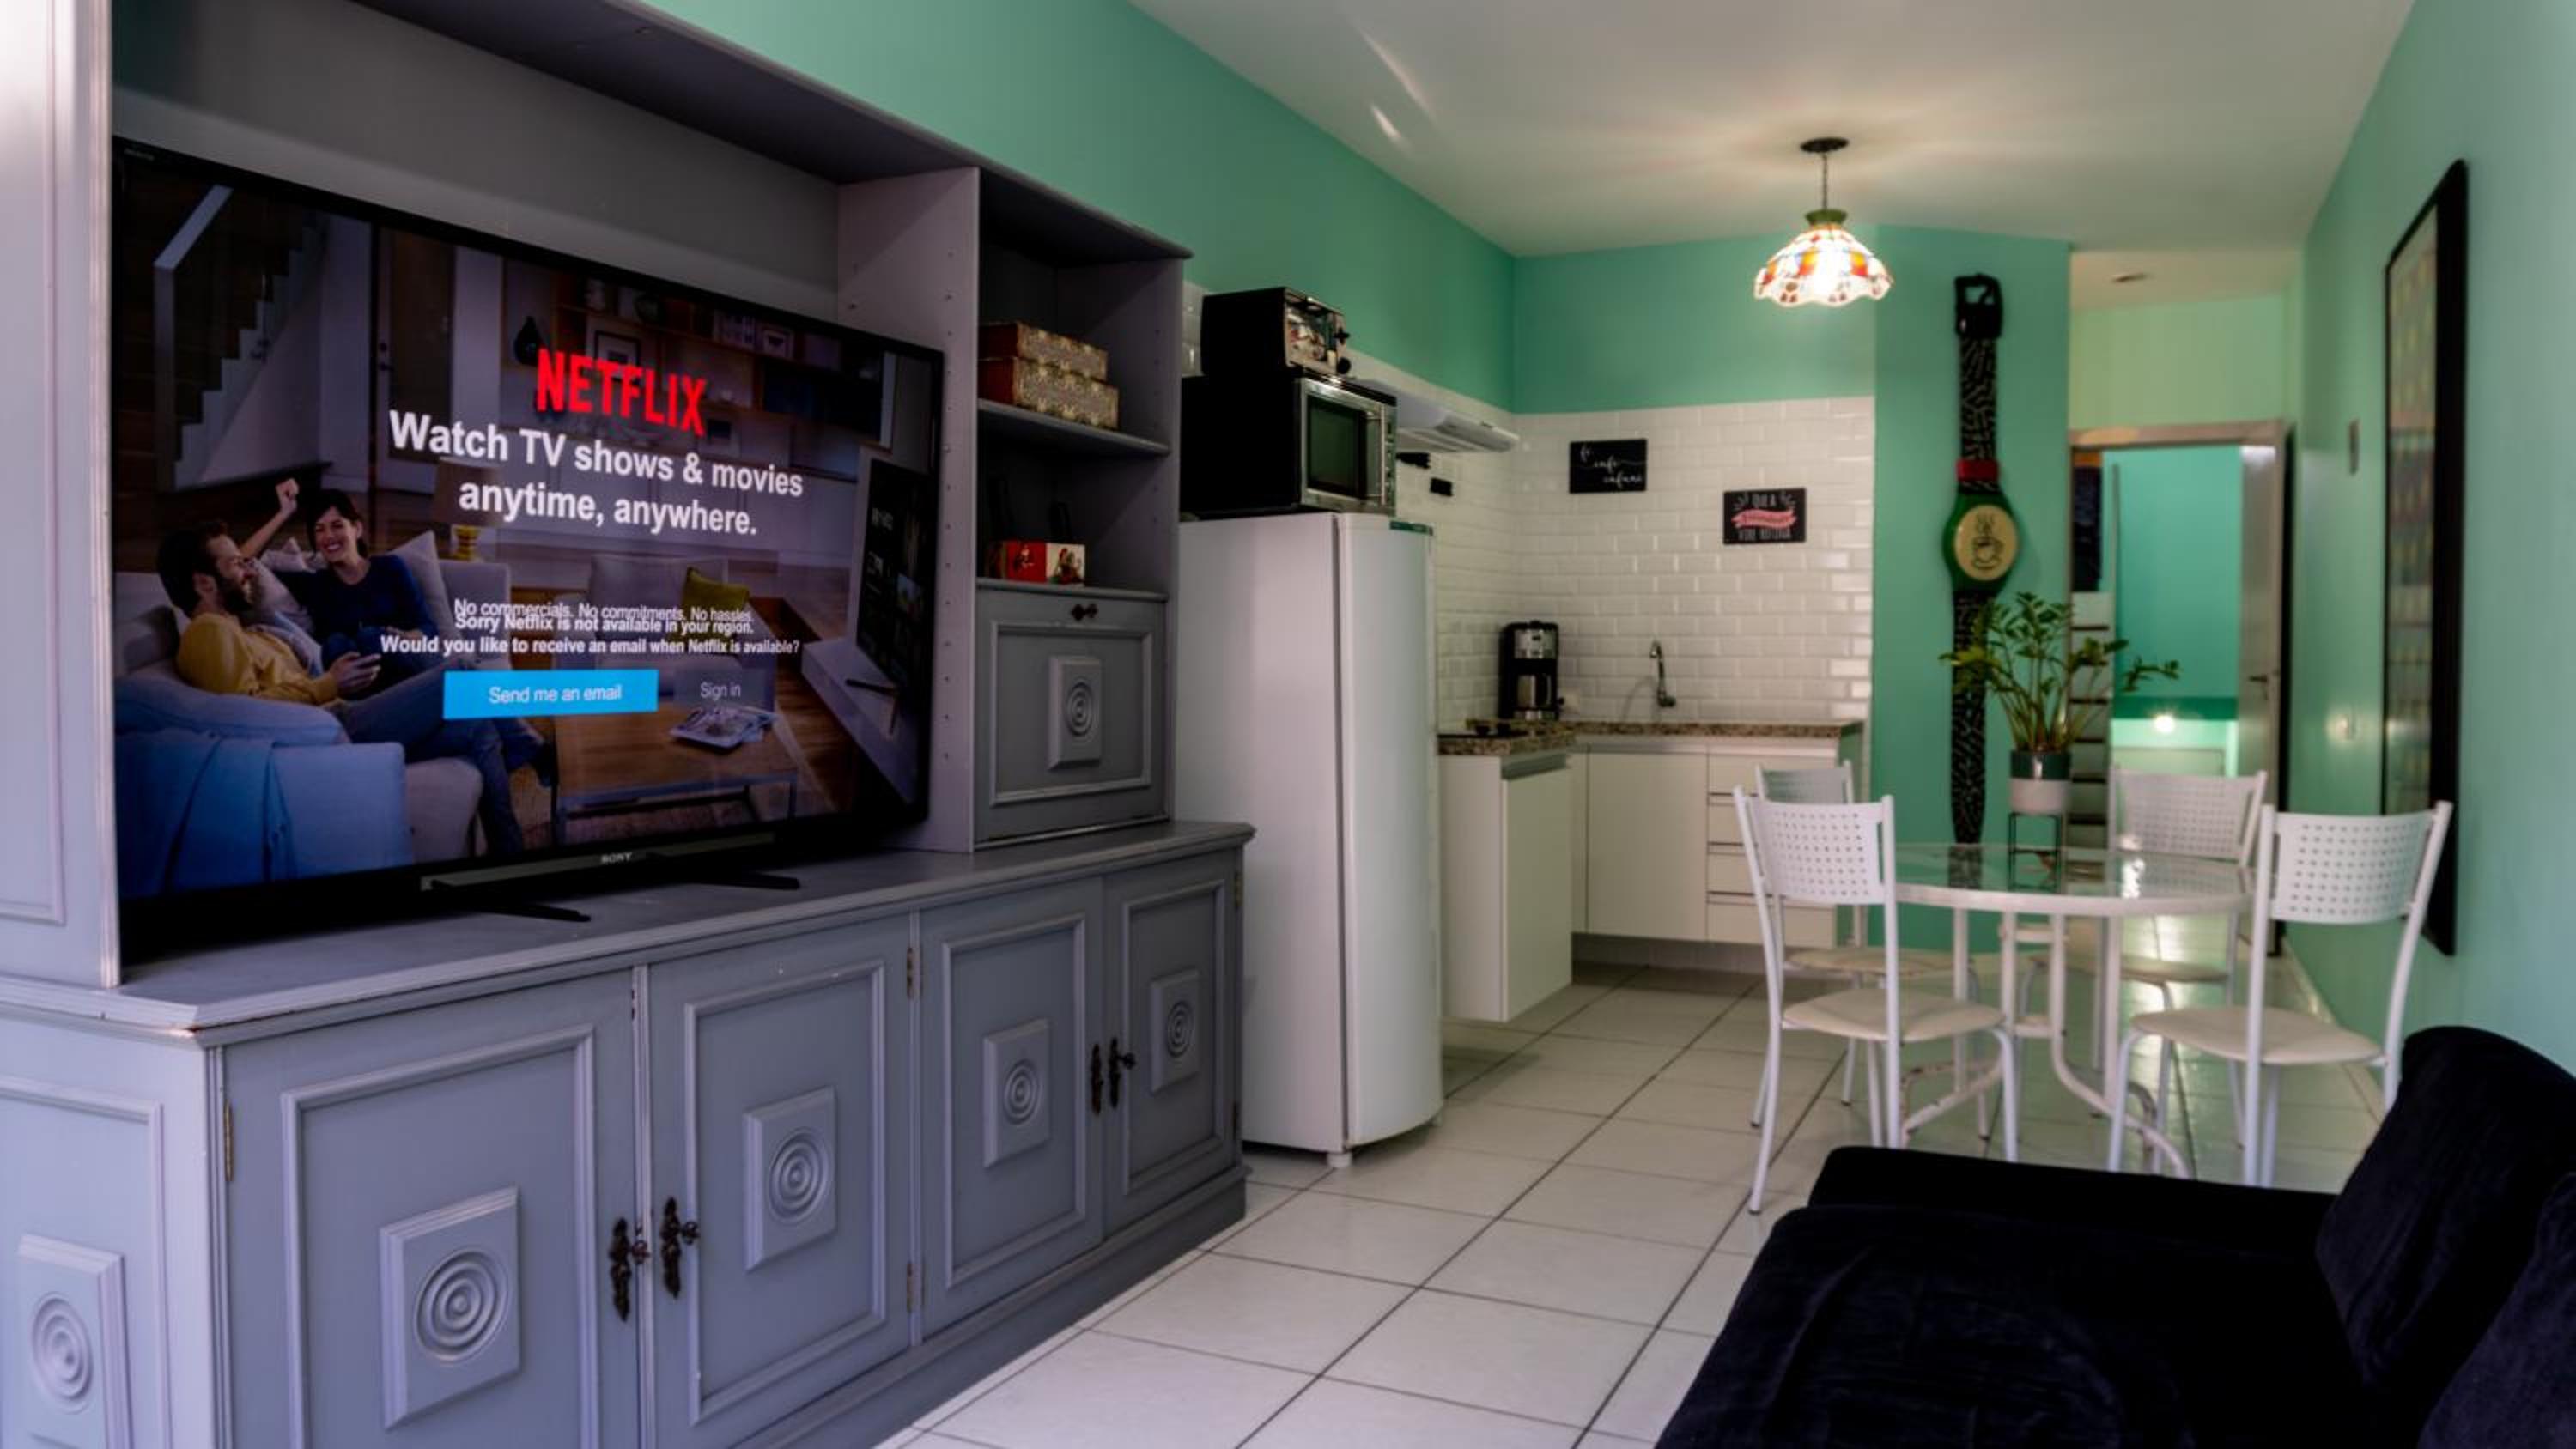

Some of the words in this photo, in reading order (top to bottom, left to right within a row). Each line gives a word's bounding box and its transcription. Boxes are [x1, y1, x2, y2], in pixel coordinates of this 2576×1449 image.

[538, 348, 706, 435] NETFLIX
[389, 409, 508, 462] Watch
[519, 428, 567, 466] TV
[574, 437, 674, 481] shows
[683, 452, 704, 485] &
[711, 460, 804, 498] movies
[458, 481, 605, 525] anytime,
[614, 494, 758, 536] anywhere.
[454, 598, 477, 615] No
[480, 603, 574, 617] commercials.
[579, 603, 598, 619] No
[601, 606, 686, 621] commitments.
[690, 607, 708, 621] No
[455, 614, 501, 633] Sorry
[505, 615, 554, 630] Netflix
[557, 616, 570, 630] is
[574, 618, 598, 631] not
[602, 618, 662, 633] available
[665, 620, 677, 632] in
[681, 621, 710, 636] your
[712, 622, 754, 636] region.
[380, 636, 439, 652] Would
[443, 640, 475, 658] you
[480, 636, 508, 653] like
[513, 638, 528, 652] to
[532, 638, 586, 653] receive
[589, 641, 606, 653] an
[610, 639, 647, 653] email
[650, 639, 684, 653] when
[688, 639, 727, 653] Netflix
[730, 640, 740, 653] is
[744, 640, 800, 654] available?
[489, 686, 531, 704] Send
[535, 690, 557, 701] me
[562, 688, 580, 701] an
[584, 685, 622, 700] email
[700, 682, 726, 700] Sign
[729, 683, 741, 696] in
